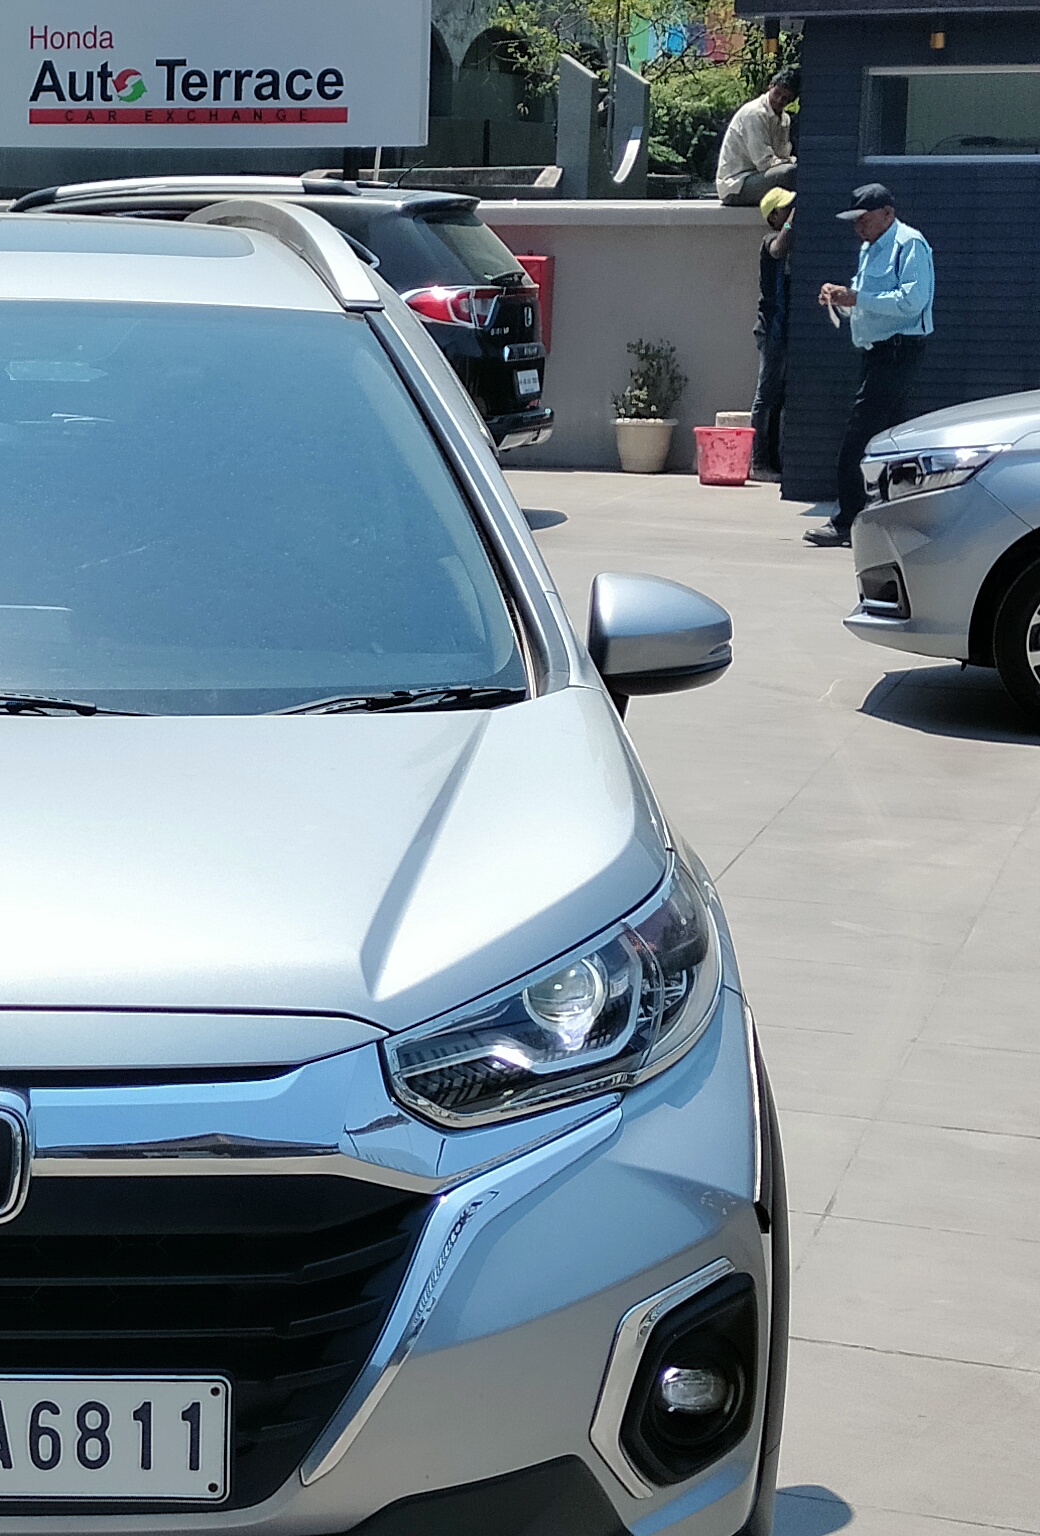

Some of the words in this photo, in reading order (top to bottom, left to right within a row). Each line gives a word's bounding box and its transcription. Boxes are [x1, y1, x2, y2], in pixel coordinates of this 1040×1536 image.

[29, 24, 114, 50] Honda
[28, 59, 148, 103] Auto
[155, 58, 345, 102] Terrace
[64, 109, 118, 122] CAR
[144, 108, 309, 122] EXCHANGE
